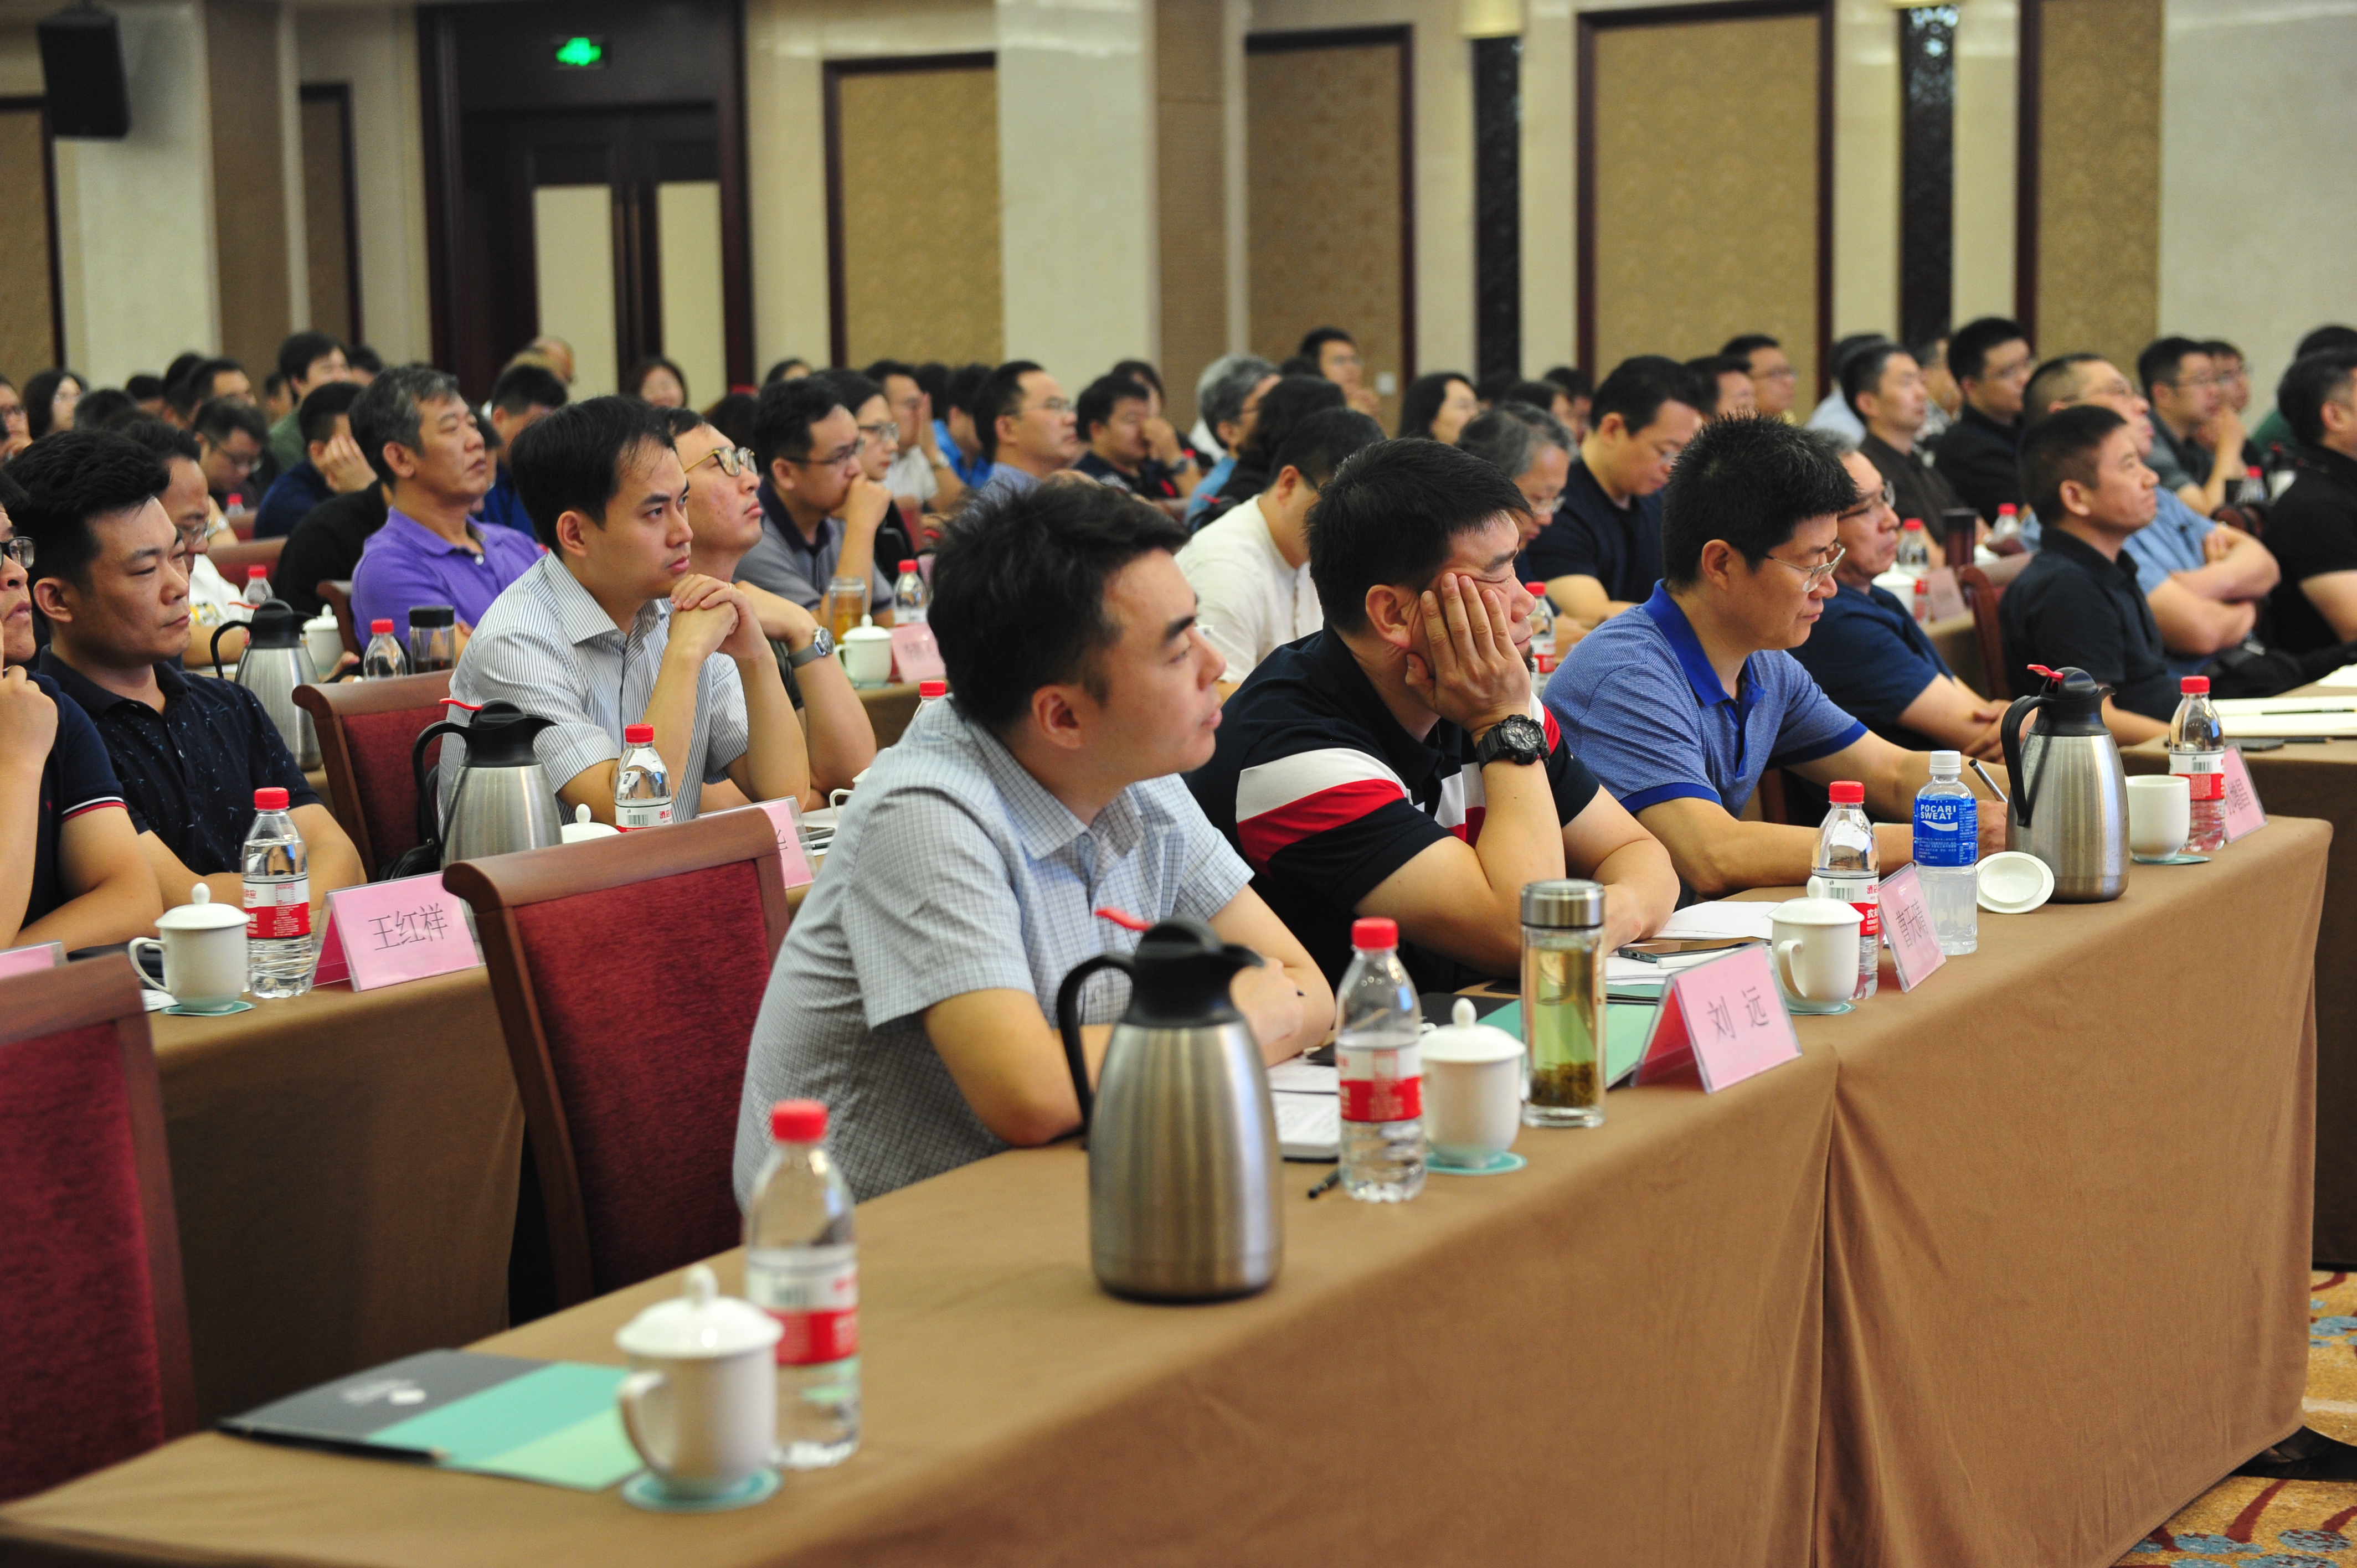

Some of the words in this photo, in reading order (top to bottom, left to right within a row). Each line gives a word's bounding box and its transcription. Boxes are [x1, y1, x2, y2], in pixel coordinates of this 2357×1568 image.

[1921, 804, 1957, 813] POCARI
[1921, 812, 1953, 820] SWEAT
[368, 903, 448, 951] 王红祥
[1896, 899, 1929, 950] 曹天晴
